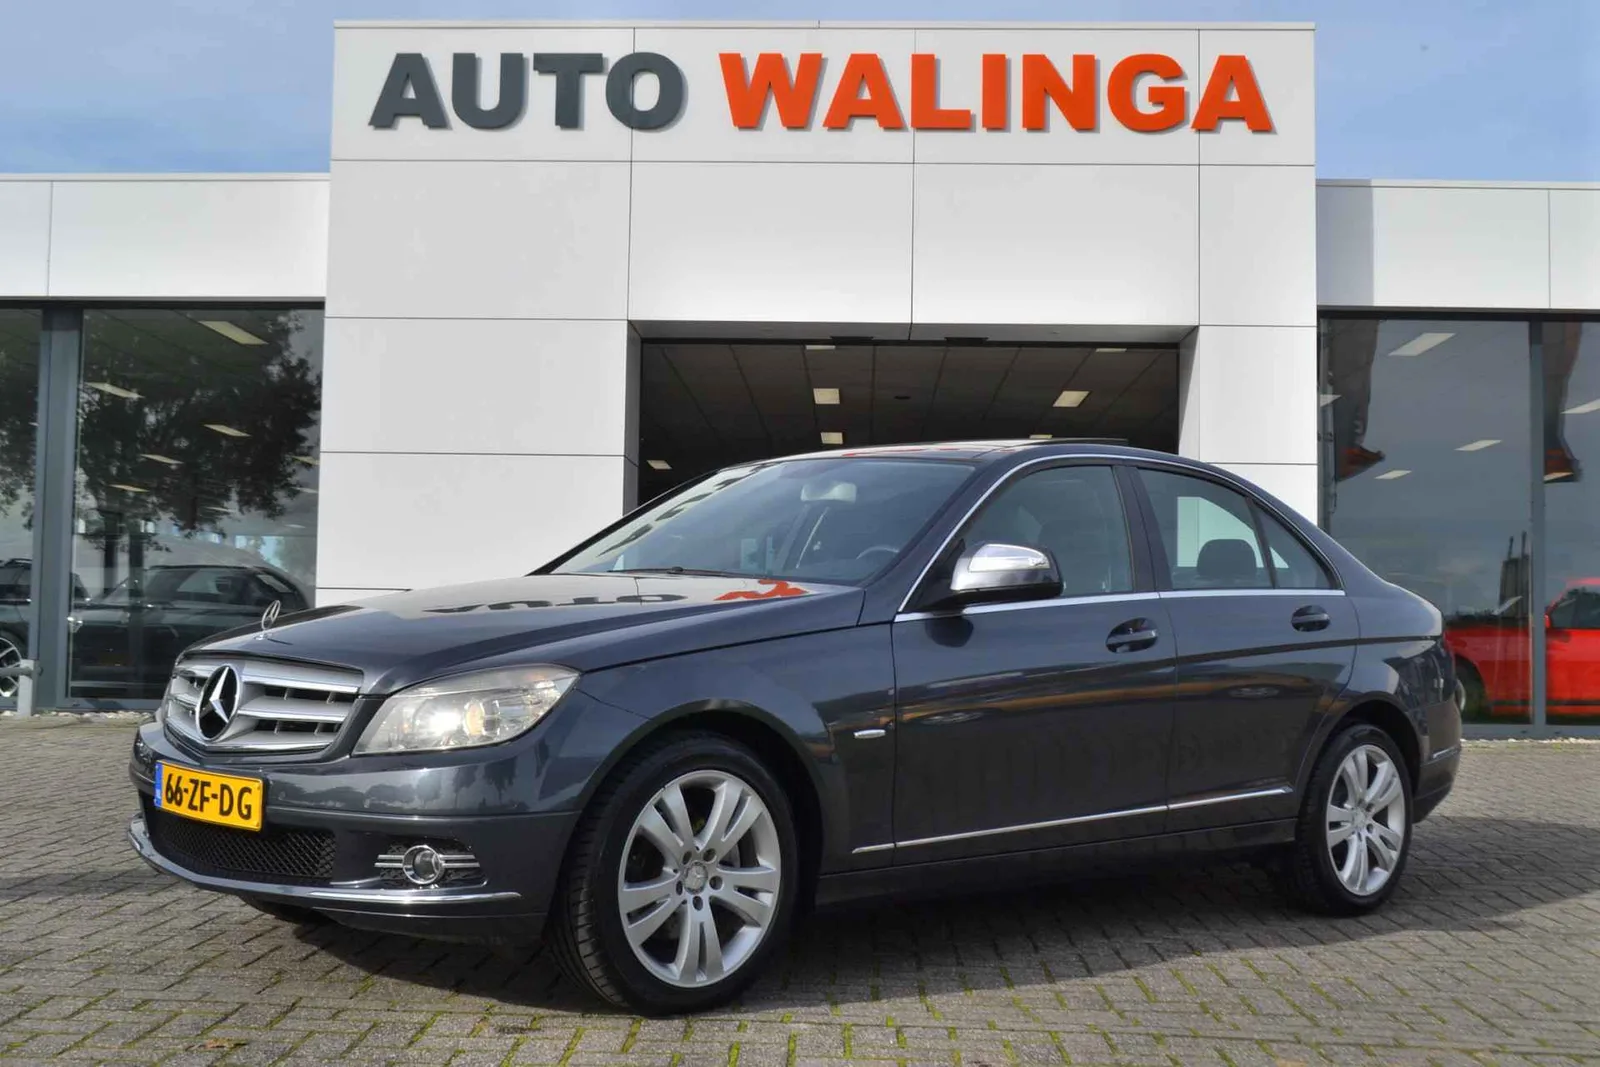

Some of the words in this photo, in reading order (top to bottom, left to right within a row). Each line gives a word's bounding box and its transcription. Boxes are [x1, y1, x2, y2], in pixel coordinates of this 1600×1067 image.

[369, 52, 686, 130] AUTO
[719, 53, 1275, 133] WALINGA
[165, 774, 252, 820] 66-ZF-DG
